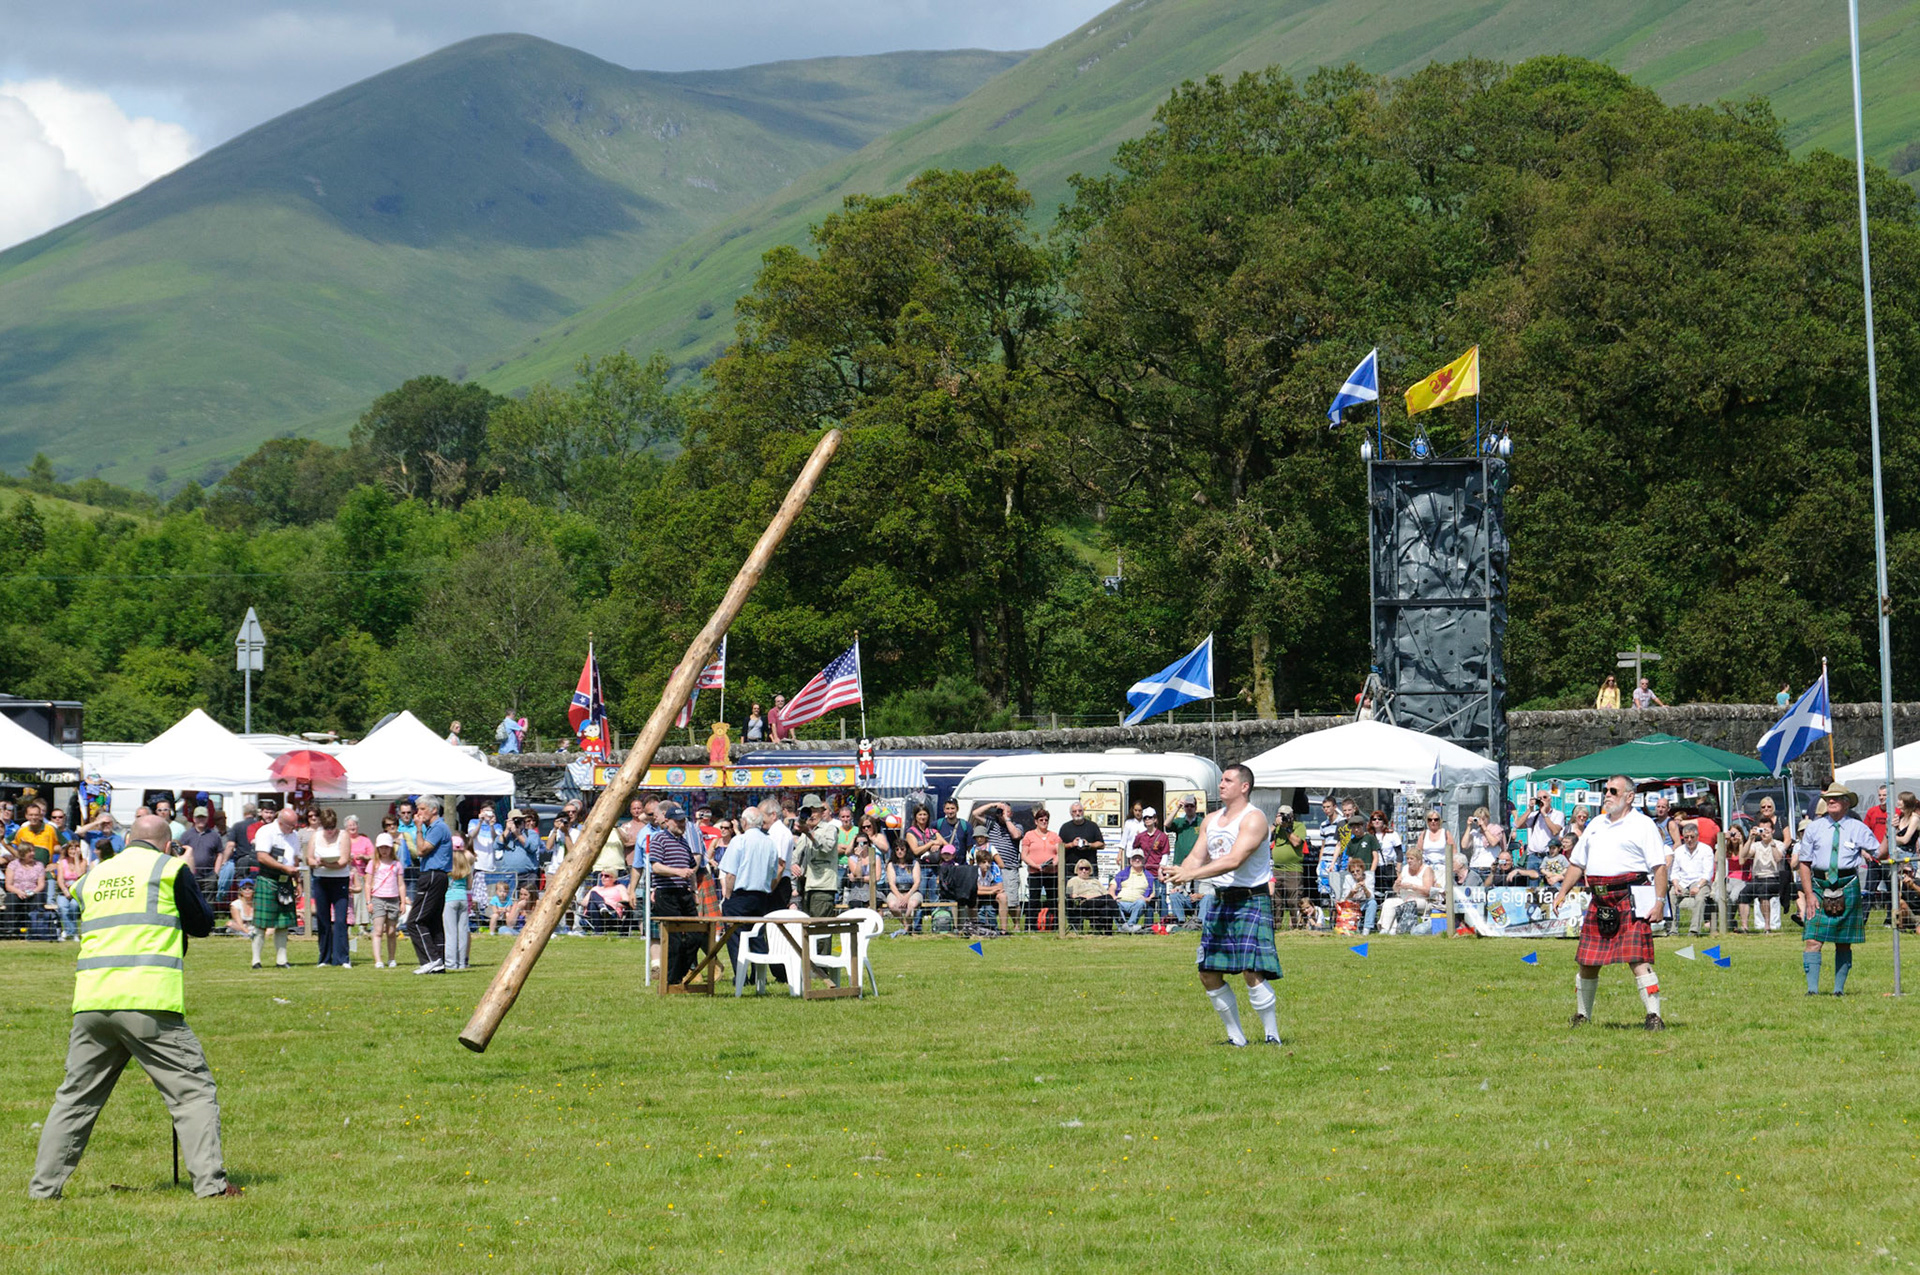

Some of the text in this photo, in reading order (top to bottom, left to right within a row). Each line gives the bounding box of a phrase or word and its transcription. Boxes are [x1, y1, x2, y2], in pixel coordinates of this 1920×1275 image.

[98, 876, 134, 888] PRESS
[94, 887, 135, 901] OFFICE
[1472, 889, 1592, 906] the sign faory
